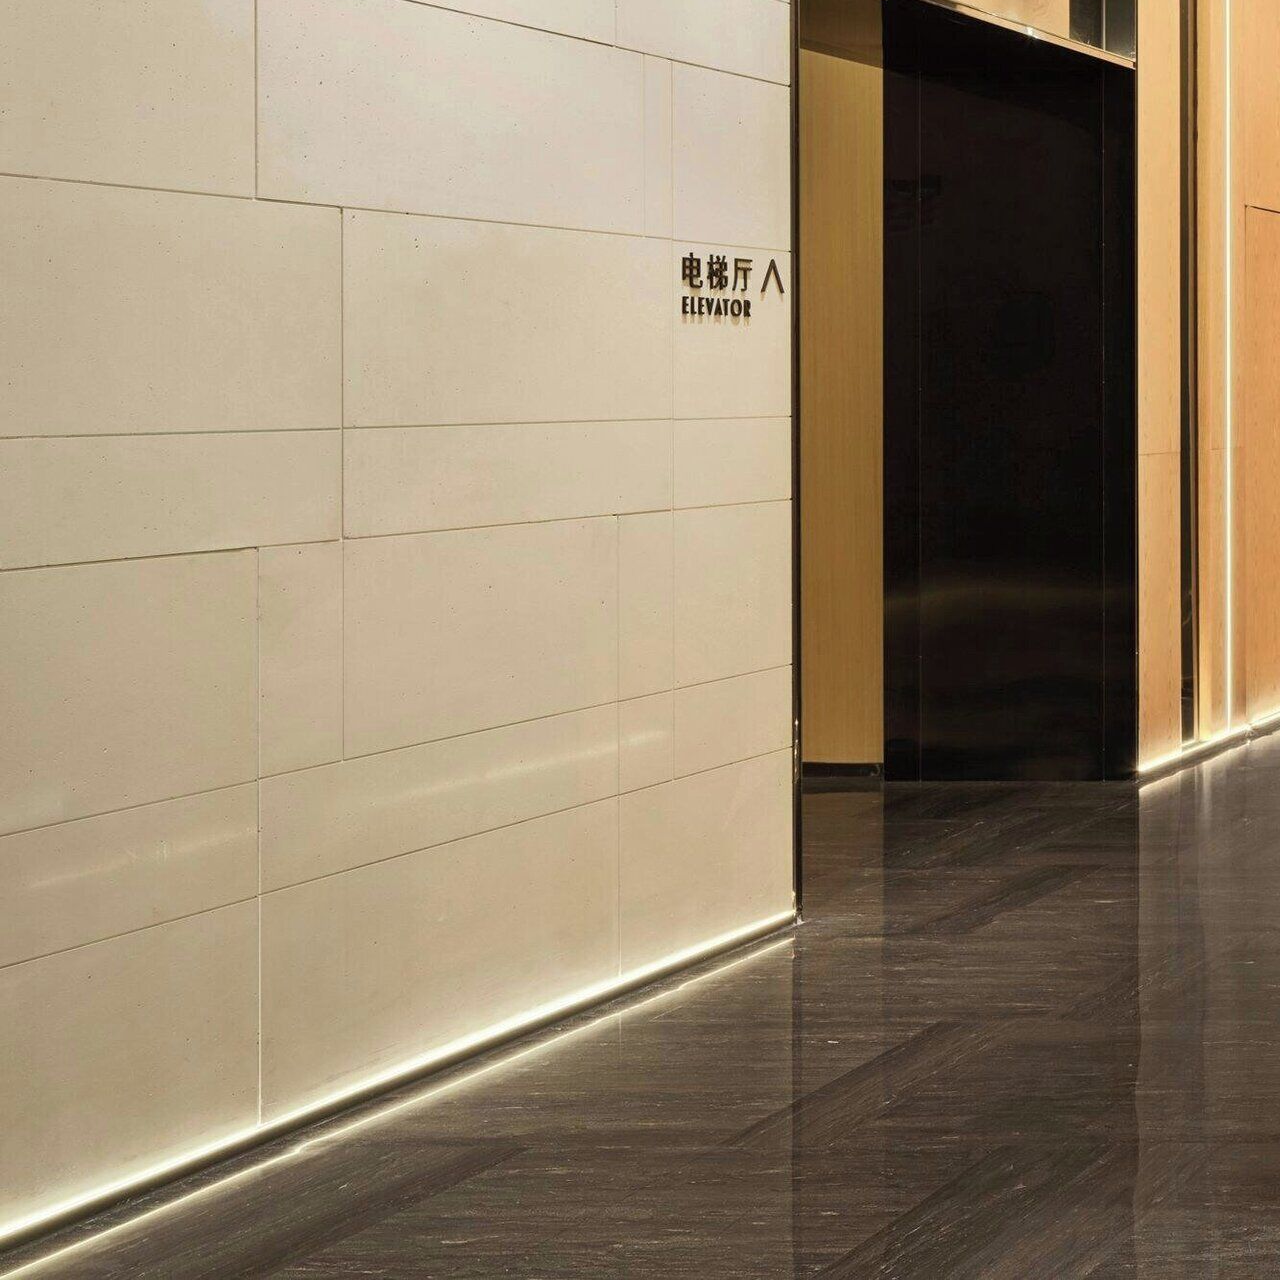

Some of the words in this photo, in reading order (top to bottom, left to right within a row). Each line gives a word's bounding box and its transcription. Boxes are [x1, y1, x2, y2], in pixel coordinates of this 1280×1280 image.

[682, 252, 753, 291] 电梯厅
[682, 296, 751, 317] ELEVATOR
